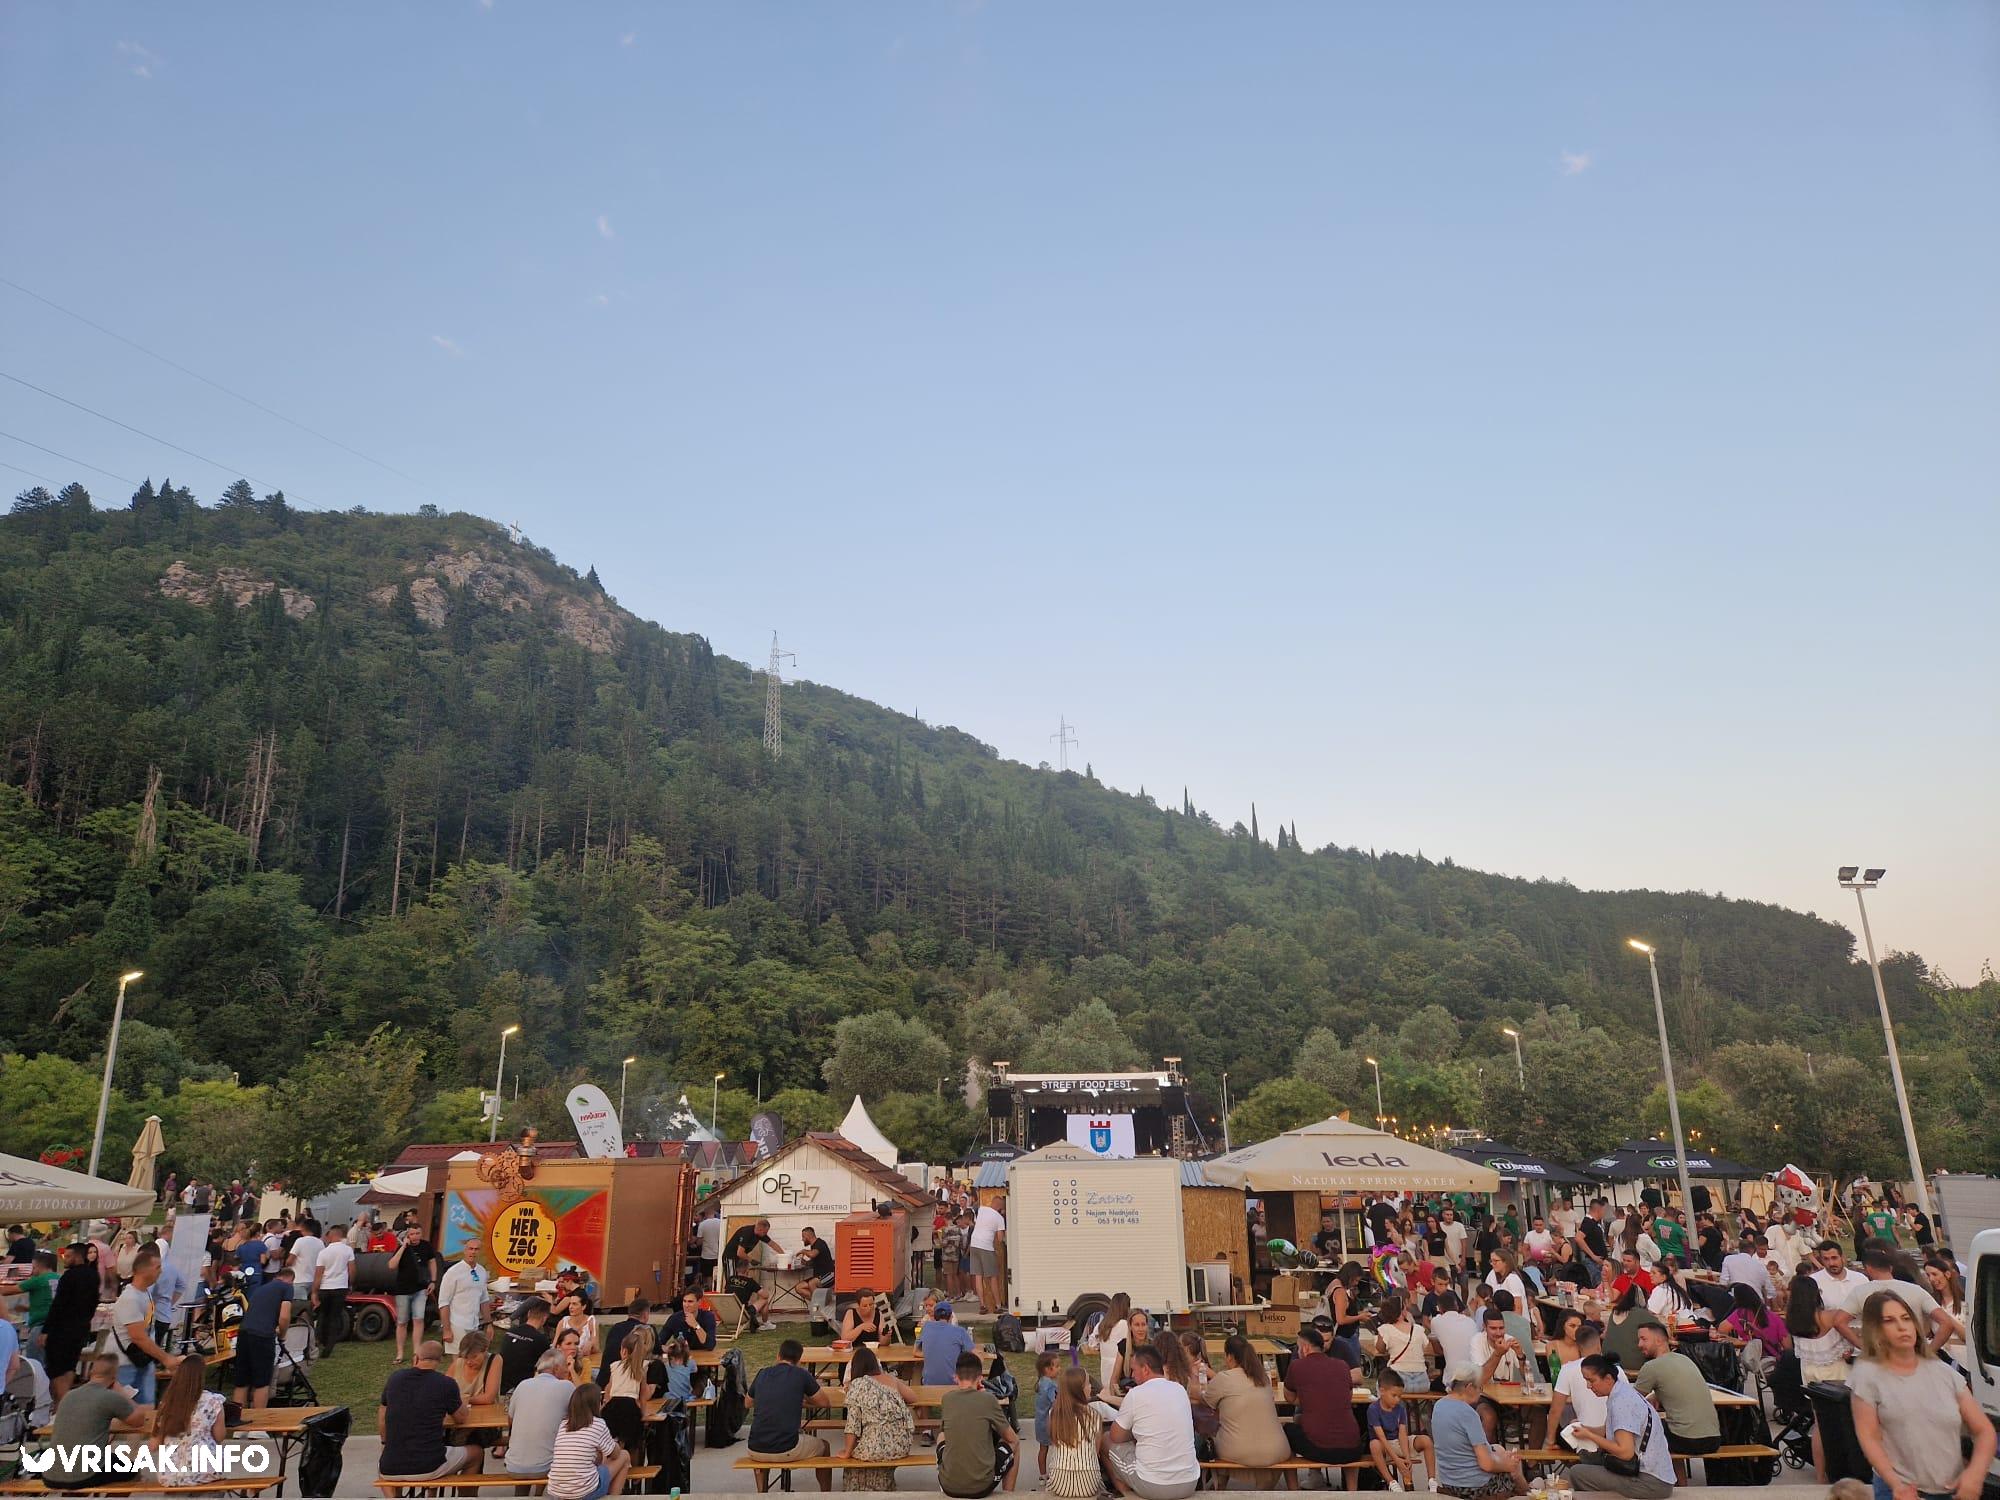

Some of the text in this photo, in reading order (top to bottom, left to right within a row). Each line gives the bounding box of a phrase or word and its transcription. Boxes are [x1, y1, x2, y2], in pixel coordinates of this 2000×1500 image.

[1041, 1079, 1132, 1089] STREET FOOD FEST
[1321, 1151, 1410, 1167] leda
[1292, 1175, 1456, 1186] NATURAL SPRING WATER
[29, 1199, 91, 1210] IZVORSKA
[98, 1199, 126, 1210] VODA
[519, 1207, 534, 1216] VON
[510, 1218, 540, 1237] HER
[508, 1238, 538, 1257] ZOG
